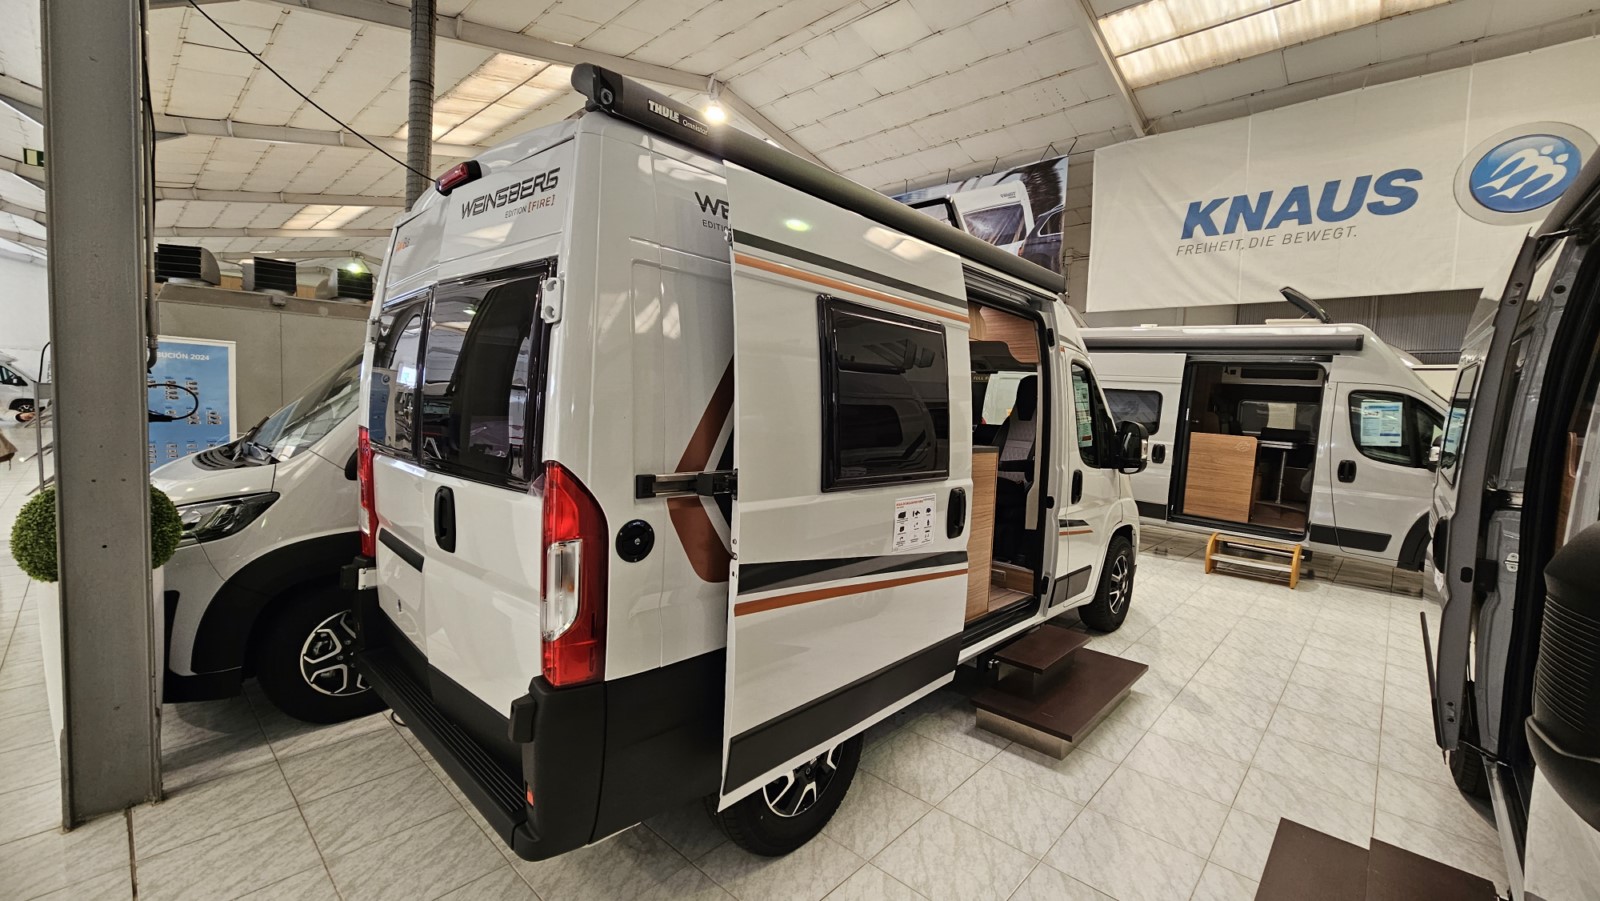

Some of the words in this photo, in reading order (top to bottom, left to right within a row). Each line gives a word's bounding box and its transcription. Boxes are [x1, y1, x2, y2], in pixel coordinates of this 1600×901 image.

[648, 99, 680, 123] THULE
[461, 166, 561, 220] WEINSBERG
[1180, 168, 1423, 240] KNAUS
[504, 205, 527, 218] EDITION
[1248, 234, 1276, 249] DIE
[1281, 225, 1357, 245] BEWEGT.
